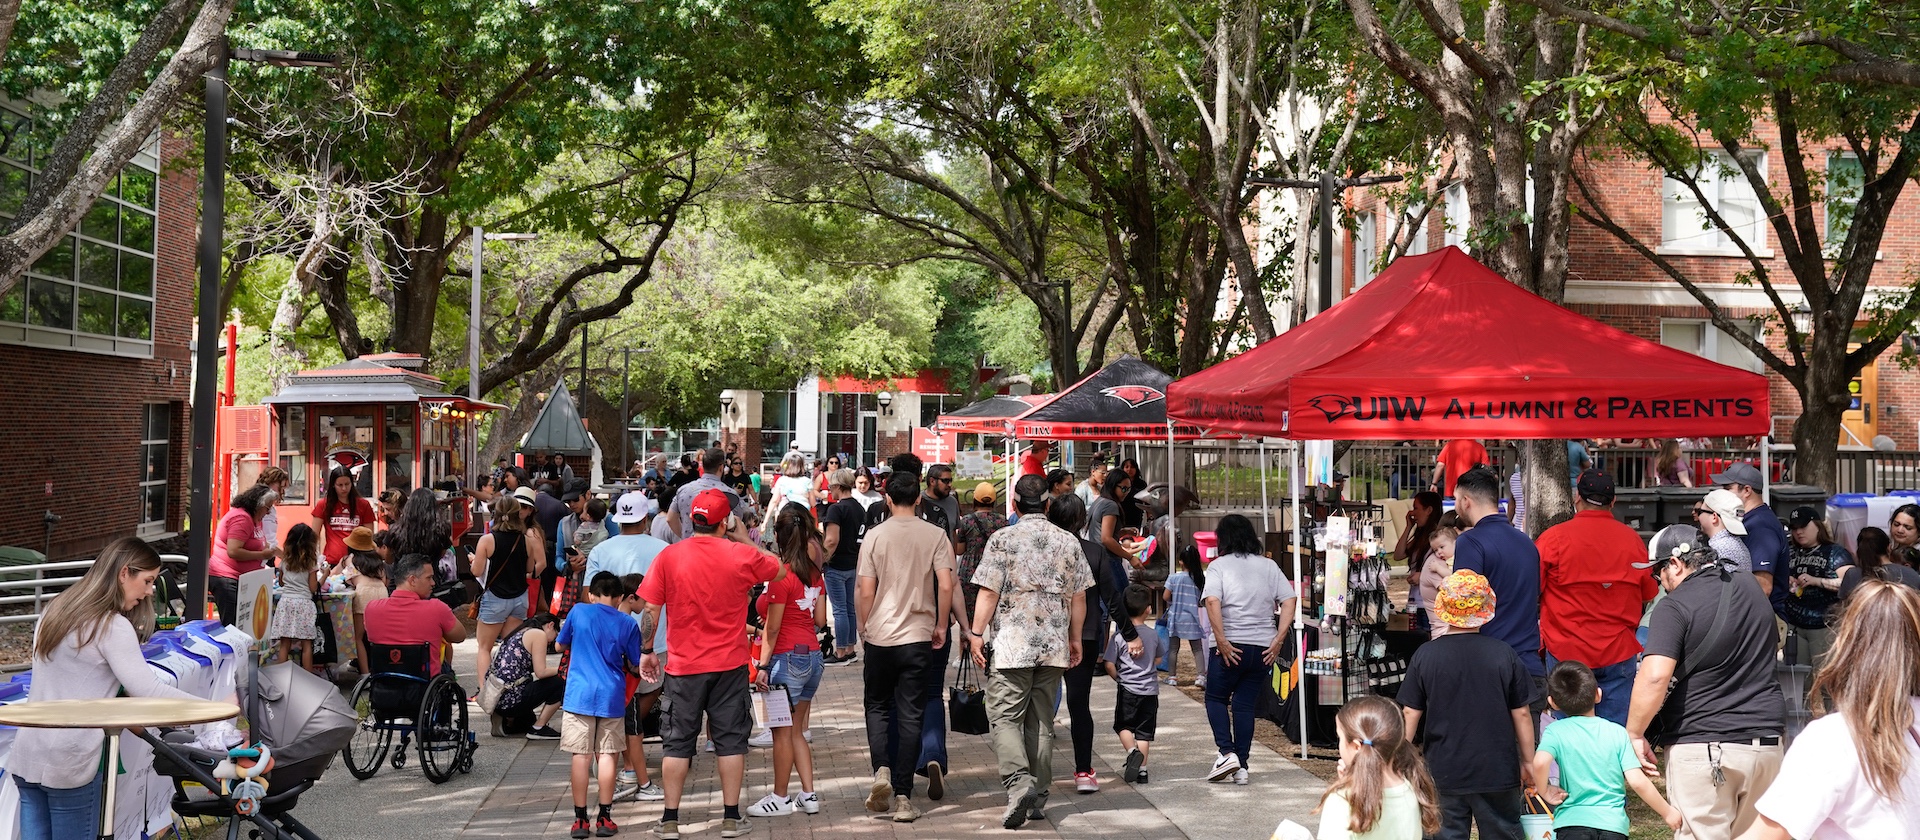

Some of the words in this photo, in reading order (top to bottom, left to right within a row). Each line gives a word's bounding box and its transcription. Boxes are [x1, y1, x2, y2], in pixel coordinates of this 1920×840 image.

[1351, 396, 1427, 421] UIW
[1574, 396, 1598, 419] &
[1024, 426, 1053, 437] UIW
[1071, 426, 1121, 436] INCARNATE
[1124, 426, 1151, 436] WORD
